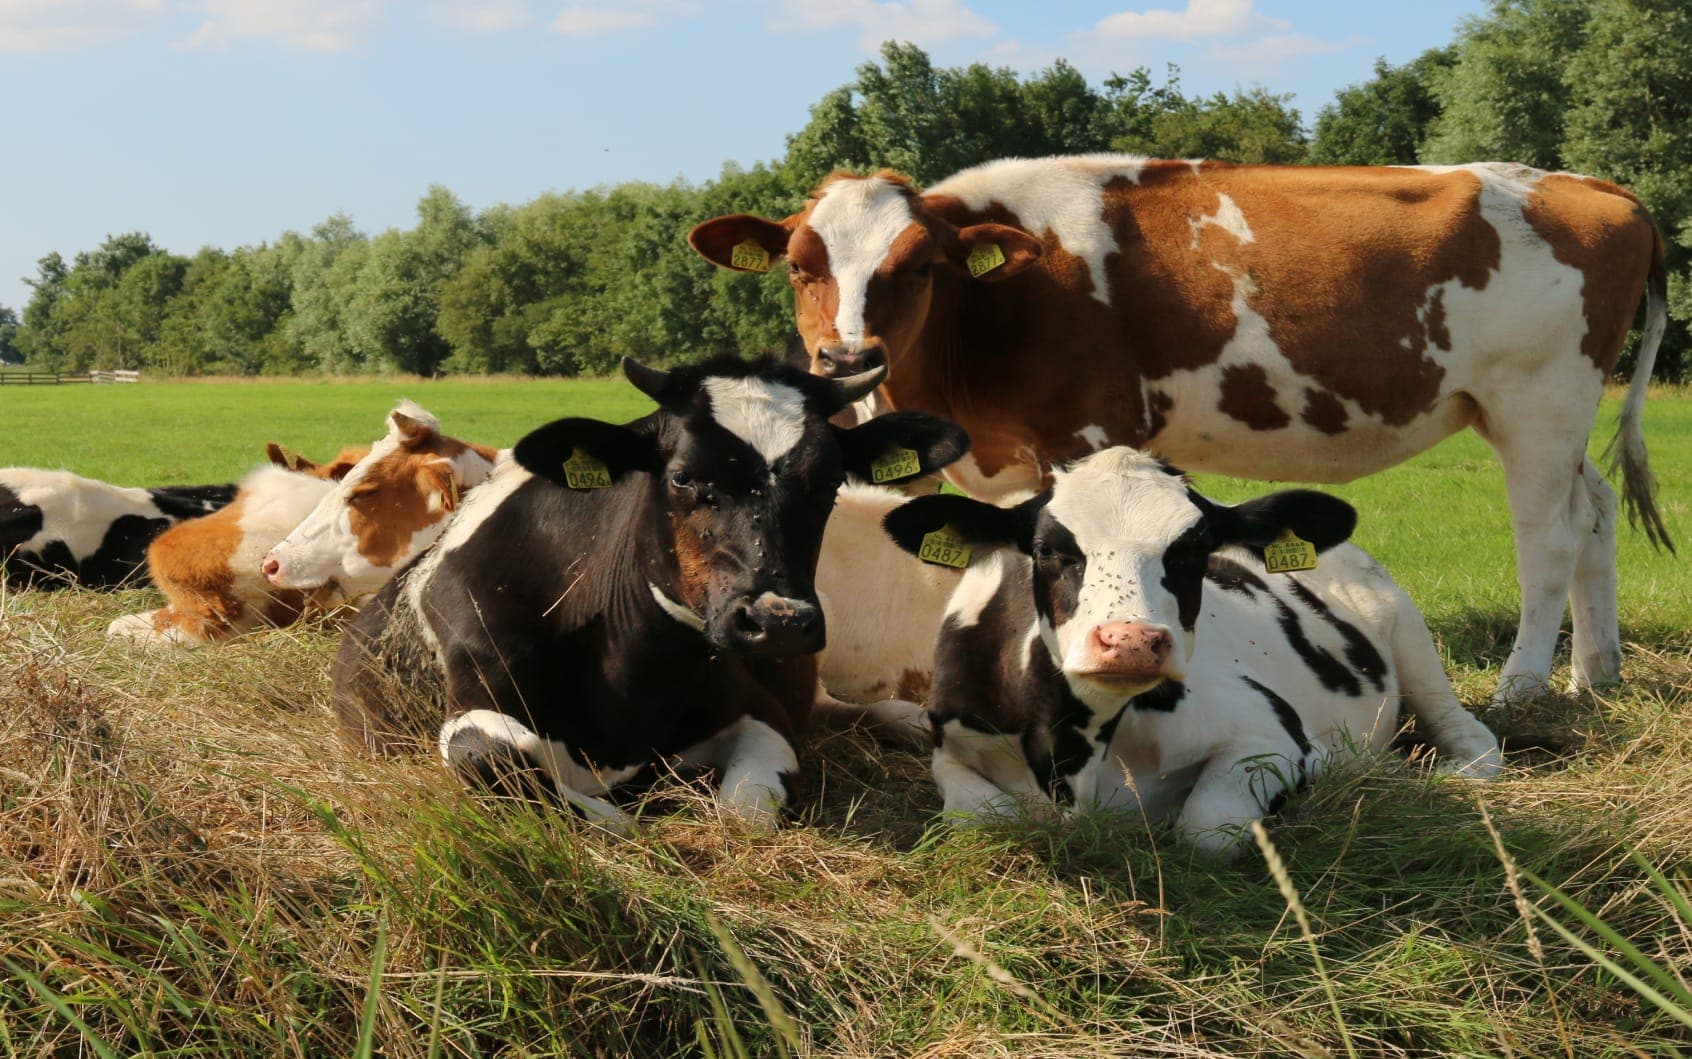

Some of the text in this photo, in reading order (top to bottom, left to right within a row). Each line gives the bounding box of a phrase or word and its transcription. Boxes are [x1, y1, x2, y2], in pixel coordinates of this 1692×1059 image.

[733, 254, 763, 268] 2877
[971, 253, 997, 276] 2877
[568, 471, 605, 487] 0496
[875, 461, 913, 482] 0496
[921, 543, 962, 564] 0487
[1268, 553, 1308, 569] 0487
